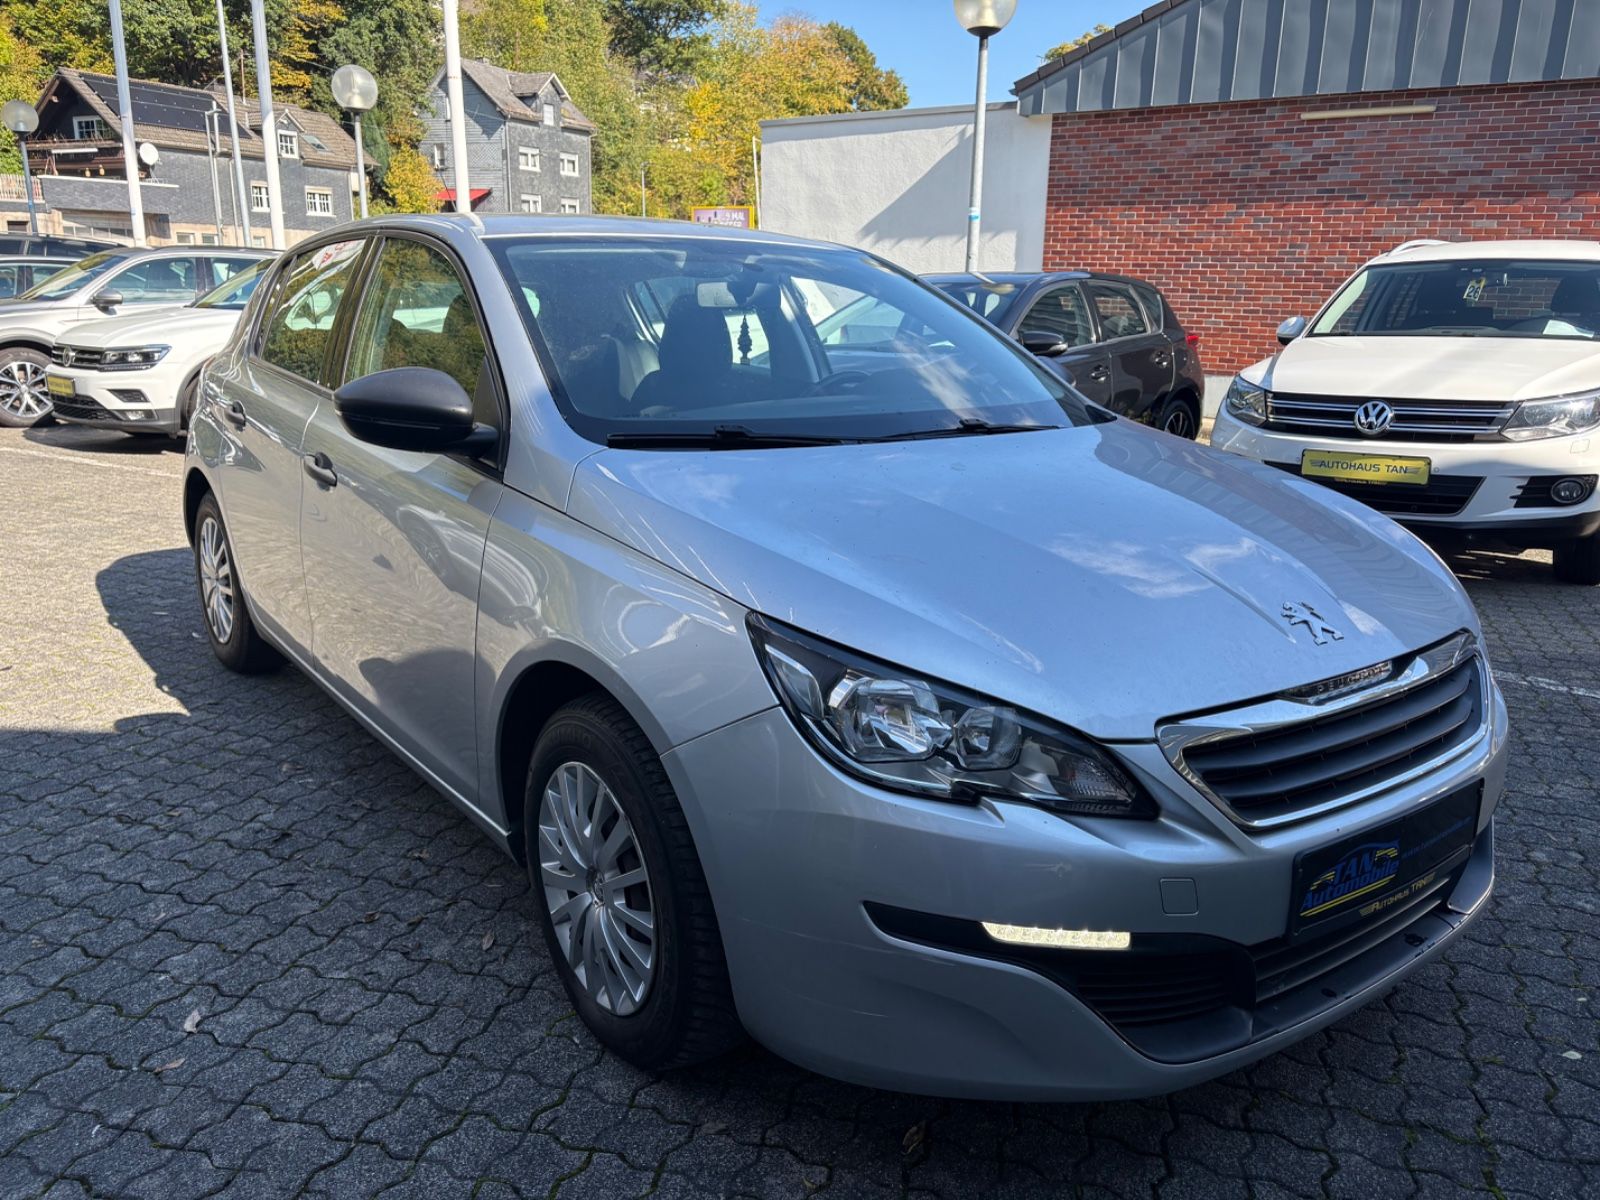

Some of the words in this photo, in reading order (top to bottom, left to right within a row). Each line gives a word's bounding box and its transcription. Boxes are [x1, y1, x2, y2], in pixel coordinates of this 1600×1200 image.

[1319, 459, 1381, 473] AUTOHAUS
[1384, 464, 1409, 474] TAN
[1302, 860, 1399, 911] Automobile
[1333, 851, 1377, 886] TAN
